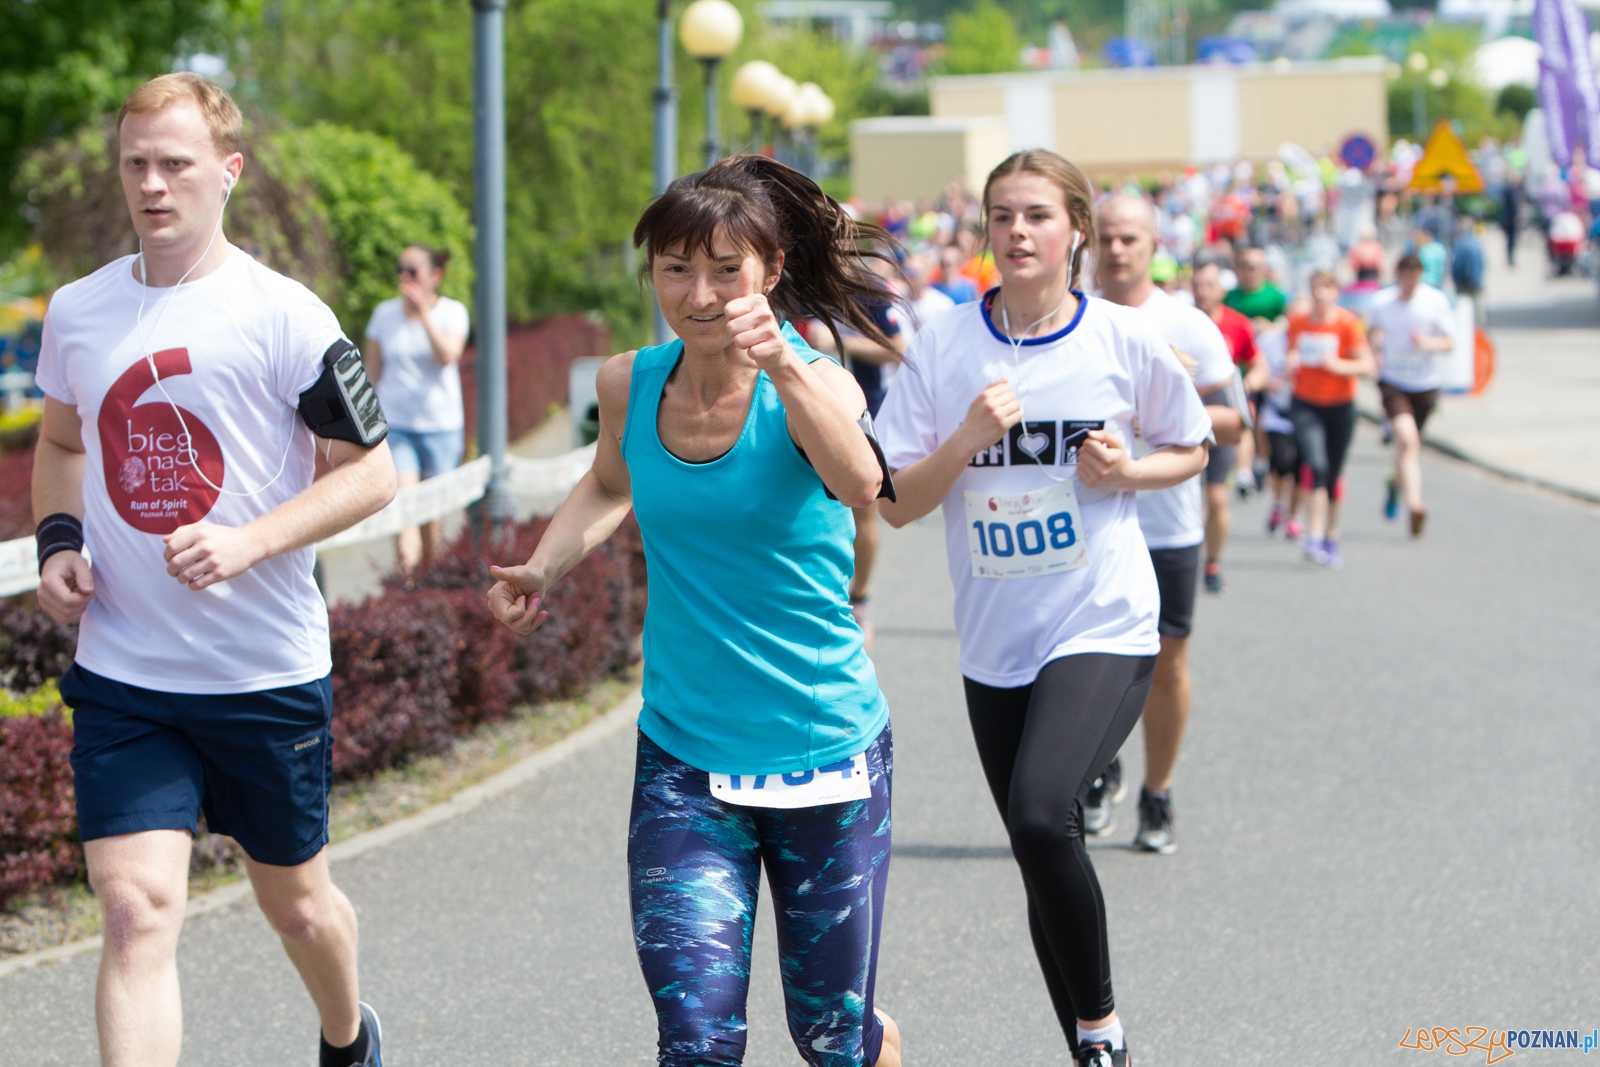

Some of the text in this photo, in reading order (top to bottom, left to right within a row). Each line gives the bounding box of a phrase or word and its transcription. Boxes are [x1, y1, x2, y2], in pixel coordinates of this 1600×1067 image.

[127, 419, 199, 466] bieg
[147, 455, 174, 471] na
[150, 470, 190, 492] tak
[130, 498, 188, 512] Run of Spirit
[972, 511, 1076, 557] 1008
